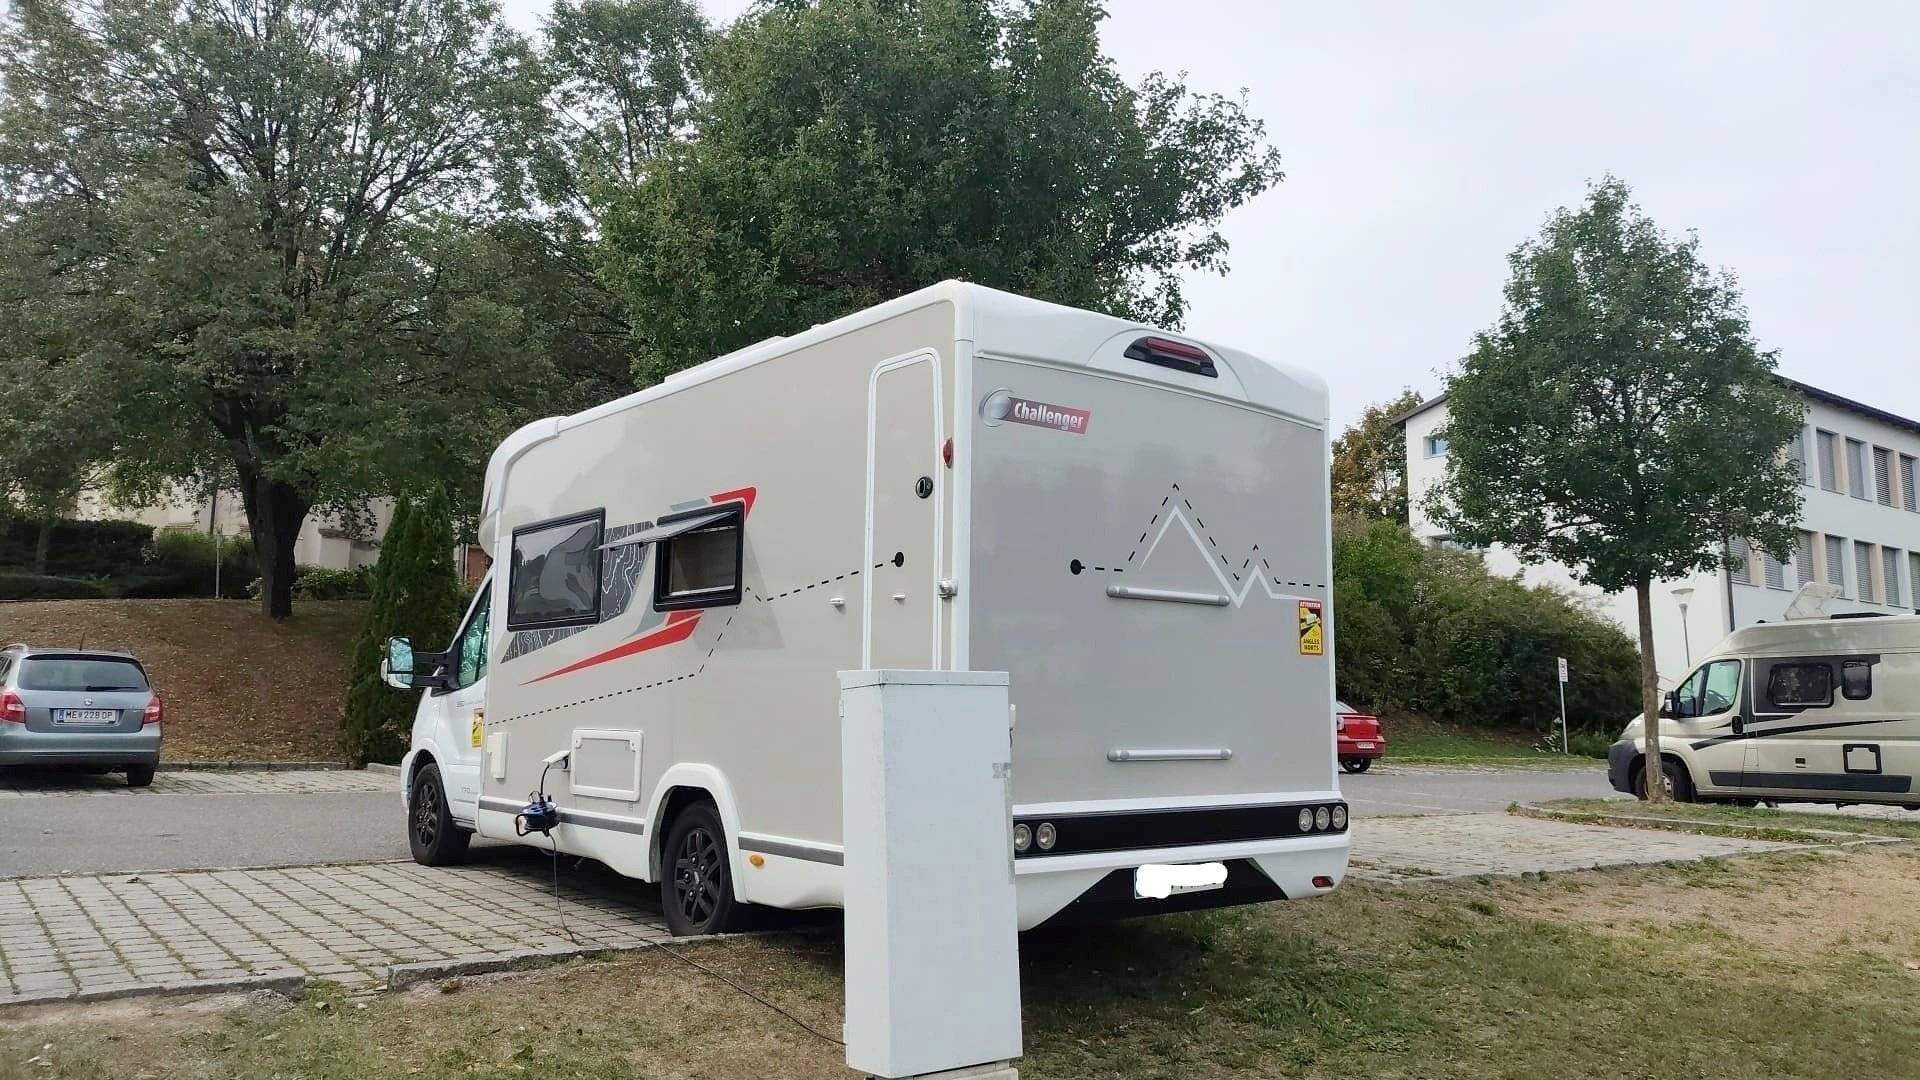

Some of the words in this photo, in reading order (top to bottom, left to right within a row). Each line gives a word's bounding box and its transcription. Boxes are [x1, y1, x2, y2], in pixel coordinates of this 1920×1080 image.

[1014, 401, 1084, 430] Challenger
[65, 711, 77, 719] ME
[83, 711, 100, 719] 228
[101, 711, 113, 720] DP
